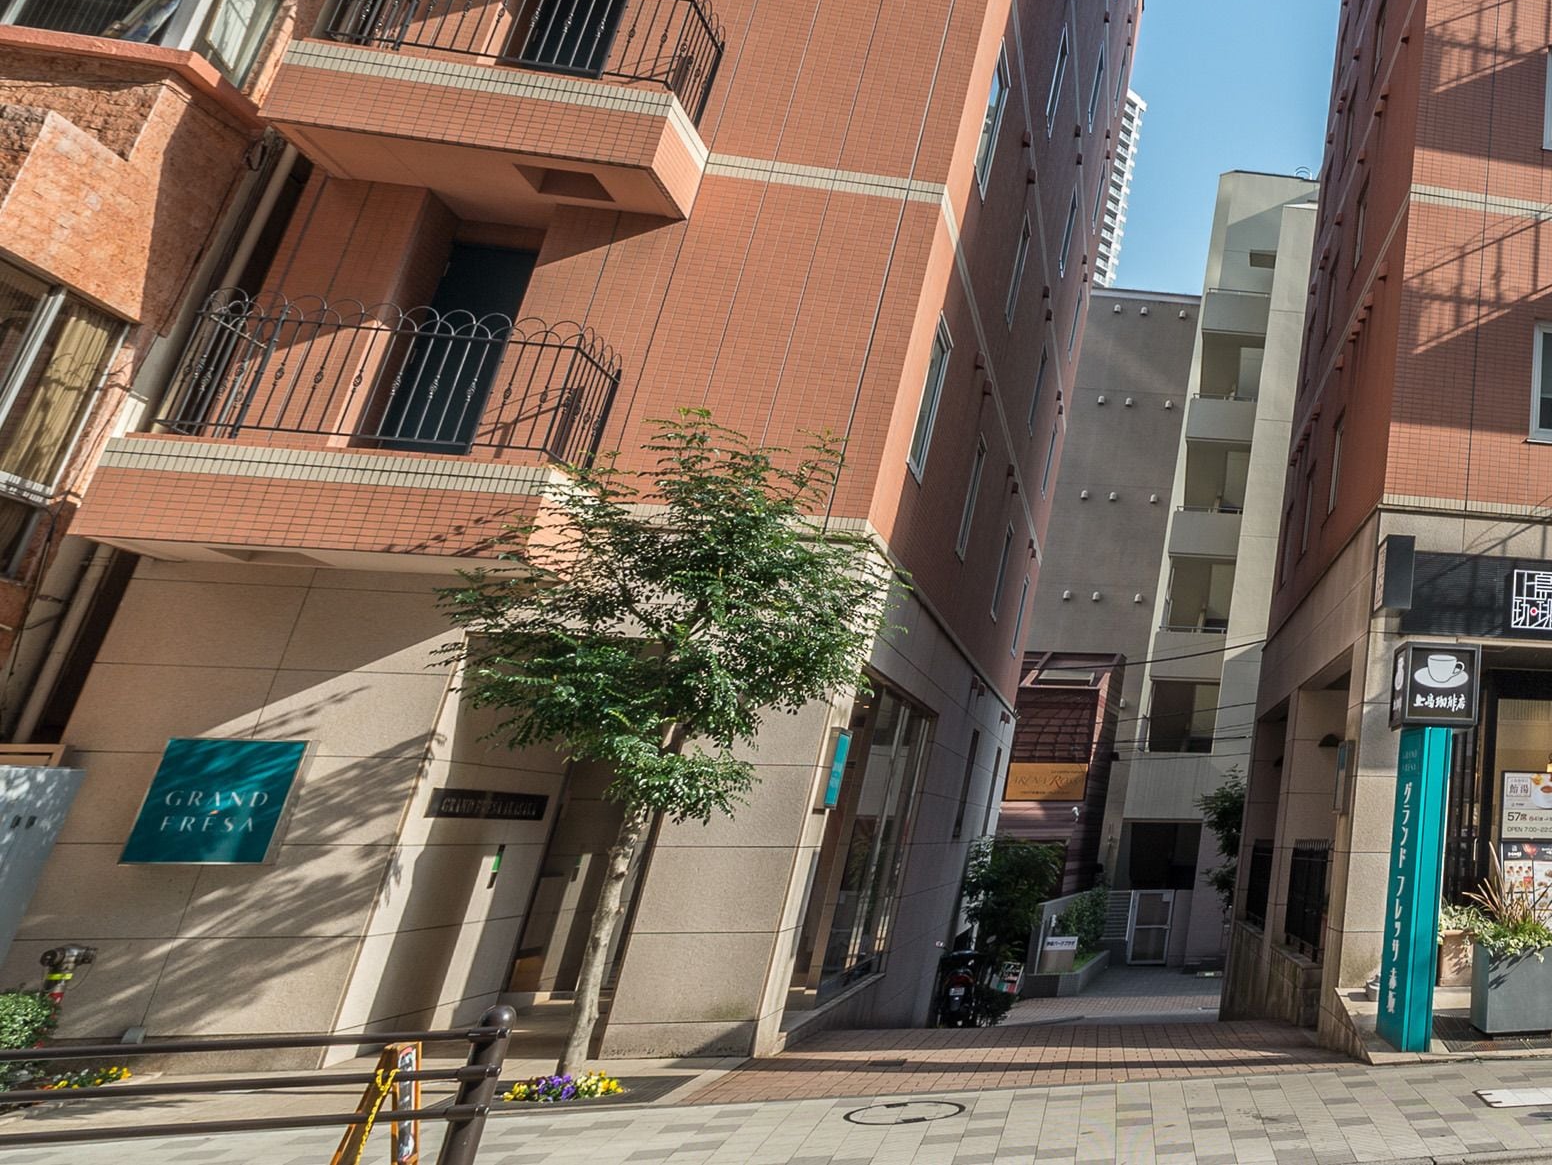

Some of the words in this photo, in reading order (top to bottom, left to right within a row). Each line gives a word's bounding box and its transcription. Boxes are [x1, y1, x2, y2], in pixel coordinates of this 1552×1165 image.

[1413, 693, 1466, 713] 上島珈琲店
[163, 790, 269, 808] GRAND
